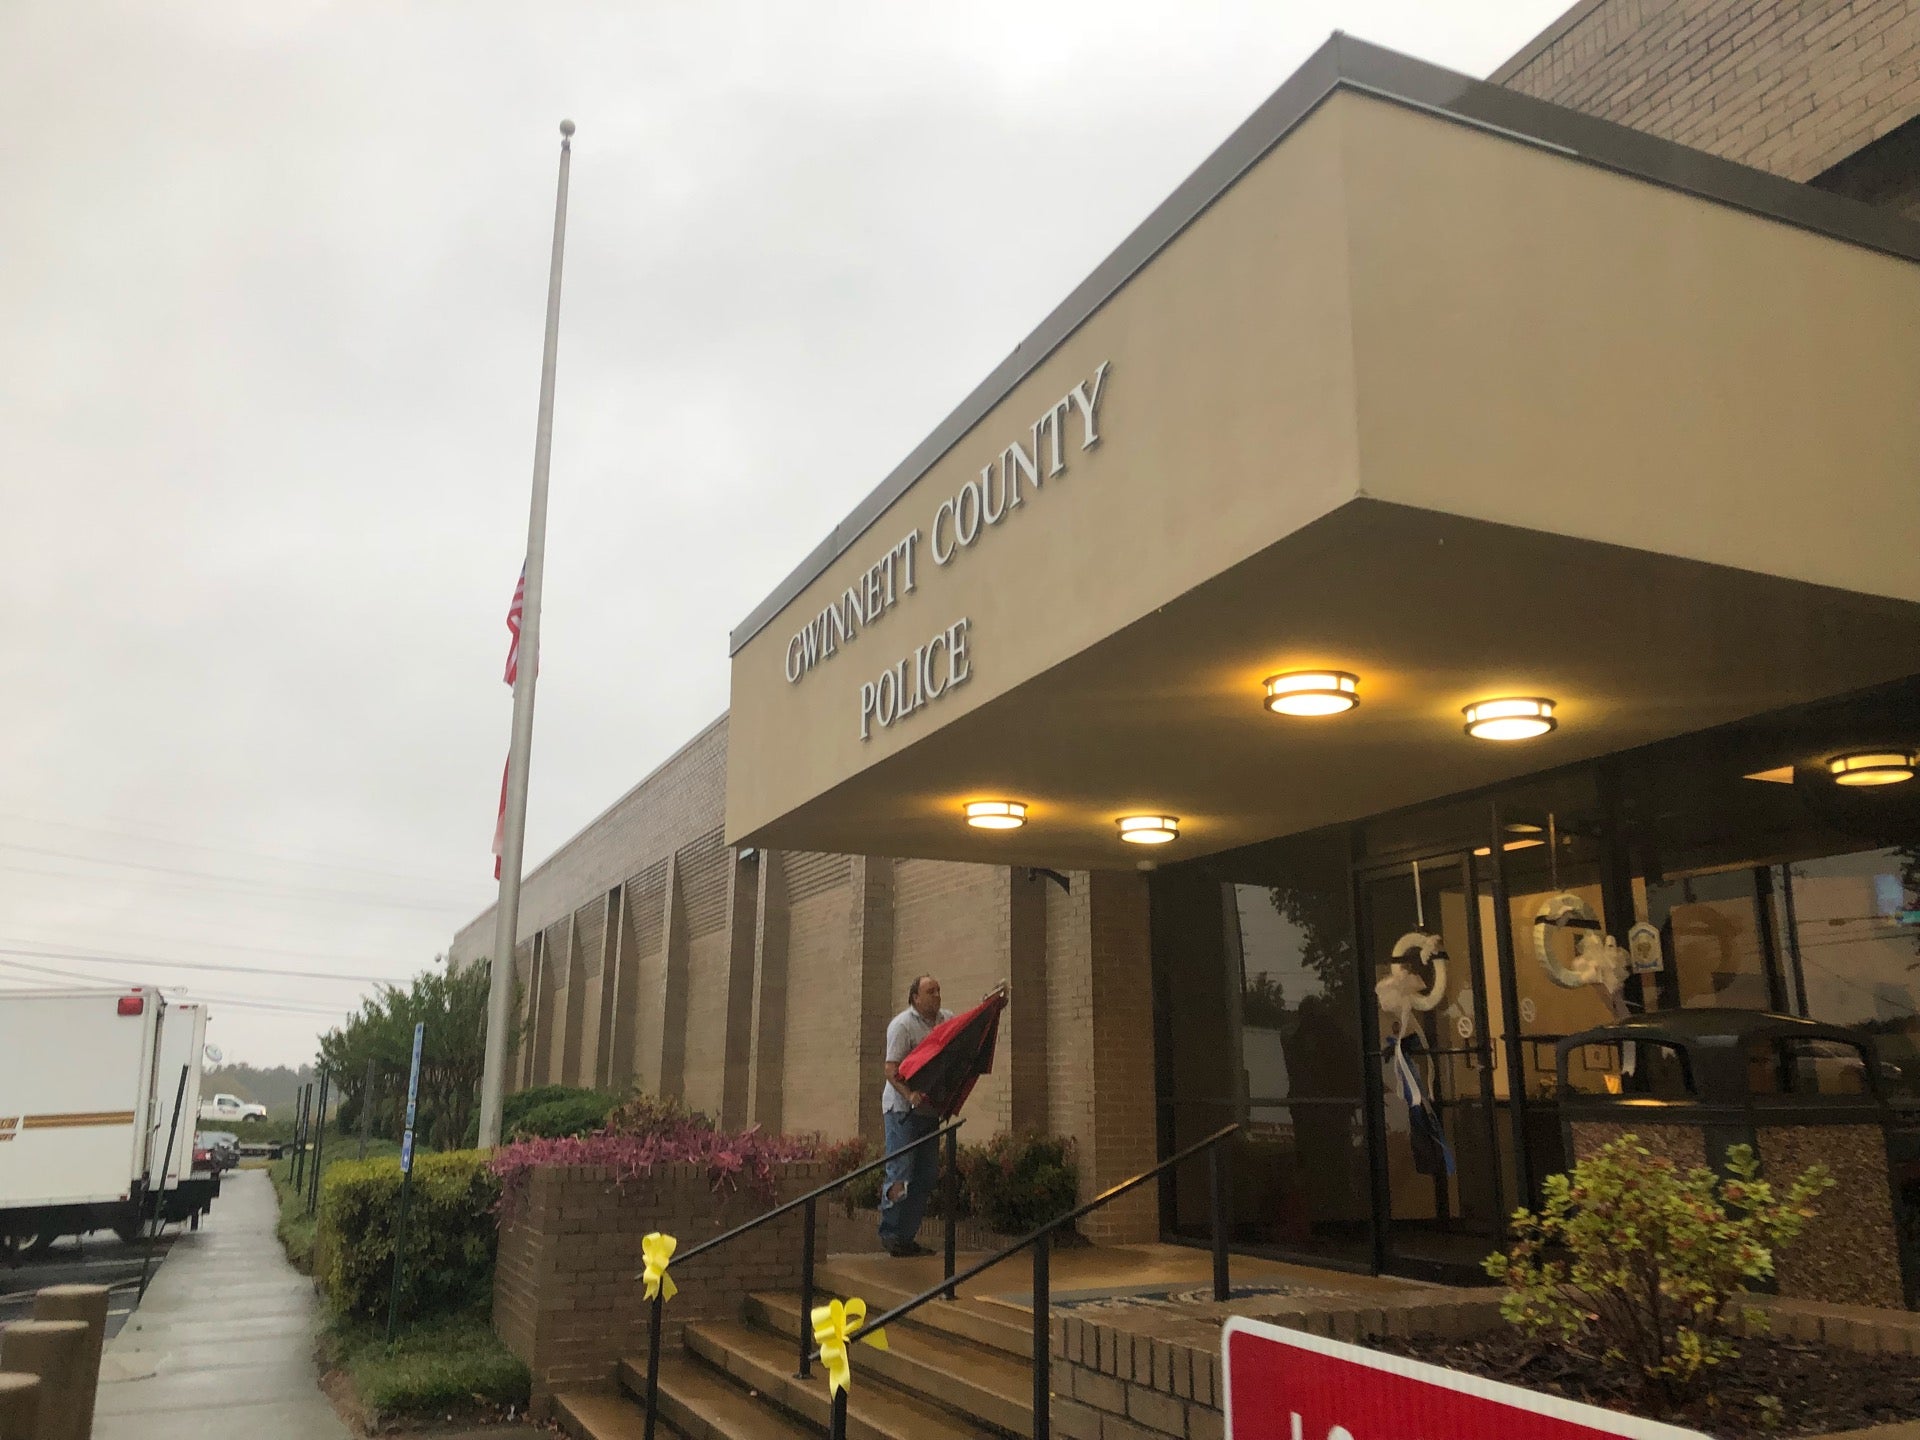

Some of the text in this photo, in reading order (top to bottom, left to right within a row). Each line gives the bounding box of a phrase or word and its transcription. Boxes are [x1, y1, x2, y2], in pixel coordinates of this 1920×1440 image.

[785, 360, 1111, 684] GWINNETT COUNTY
[859, 617, 971, 740] POLICE
